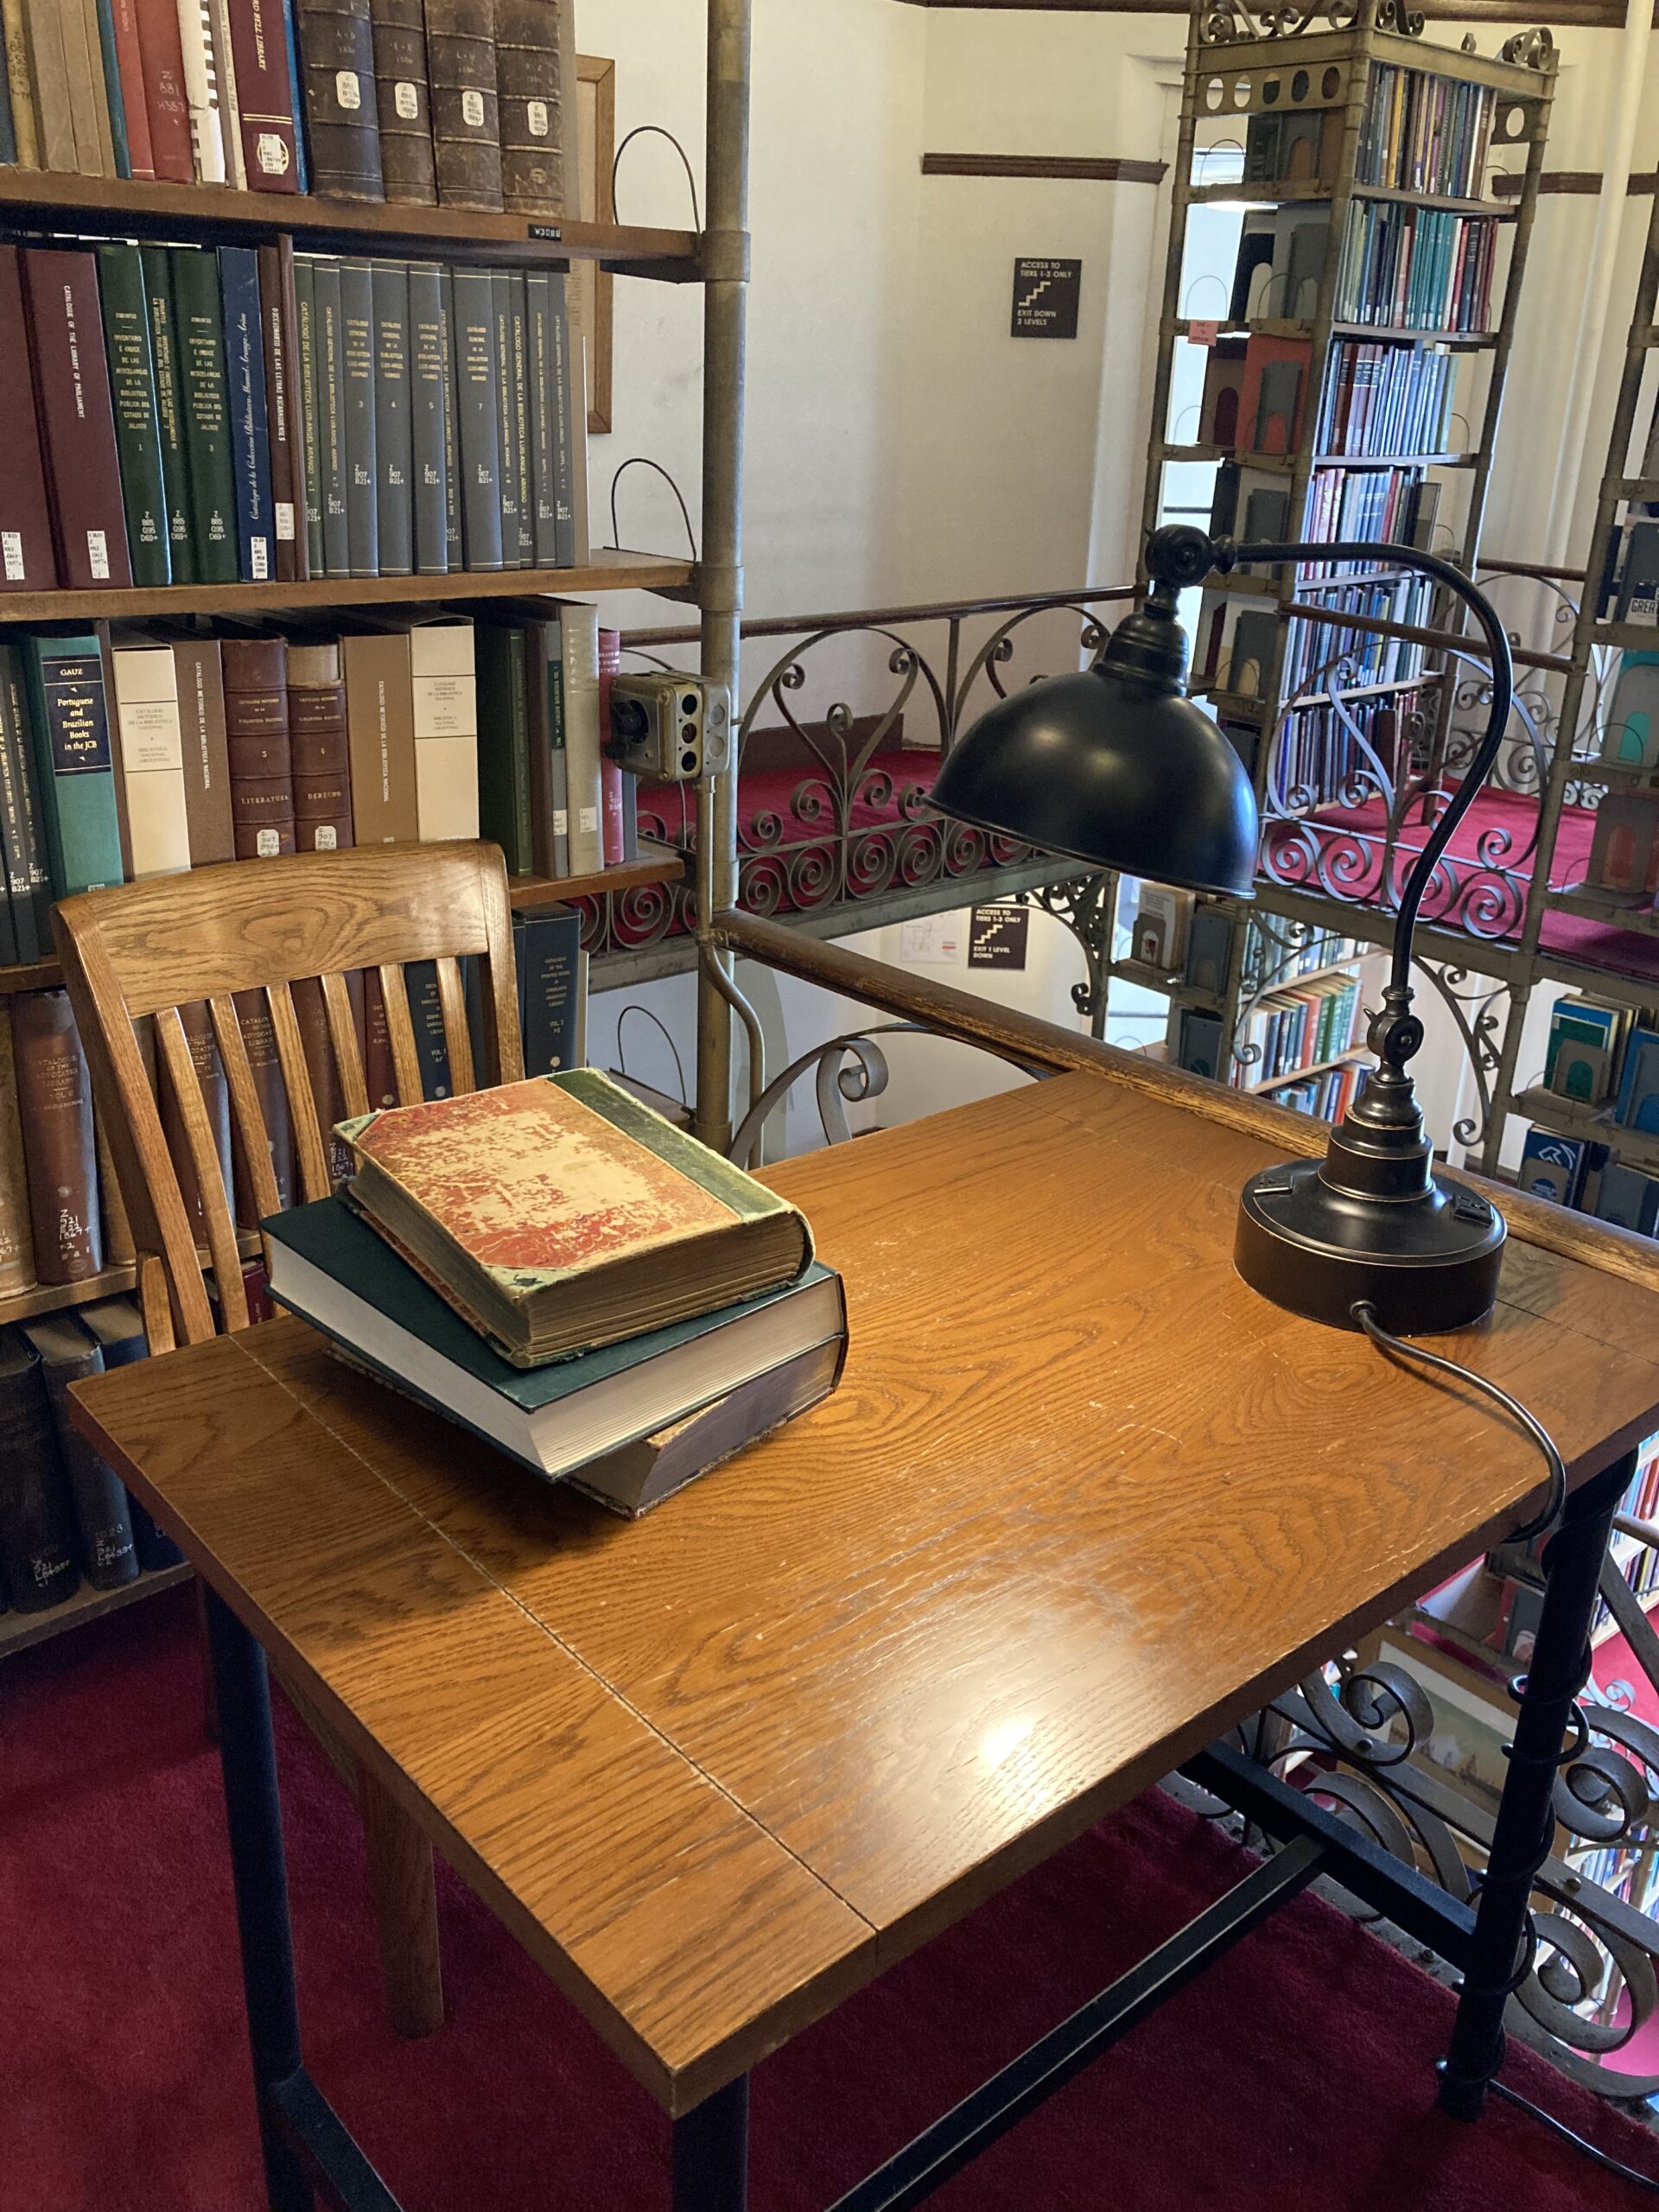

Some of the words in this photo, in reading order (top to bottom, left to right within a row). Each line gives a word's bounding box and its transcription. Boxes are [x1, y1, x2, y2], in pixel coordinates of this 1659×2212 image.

[255, 35, 266, 71] LIBRARY
[162, 71, 172, 79] Z
[63, 285, 73, 318] CATALOGUE
[272, 308, 281, 347] DICCIONARIO
[302, 341, 309, 351] DE
[70, 346, 79, 370] LIBRARY
[302, 353, 310, 362] LA
[515, 352, 524, 381] GENERAL
[303, 364, 312, 404] BIBLIOTECA
[517, 382, 524, 391] DE
[74, 383, 85, 418] PARLIAMENT
[517, 392, 524, 402] LA
[276, 396, 286, 442] NICARAGUENSES
[518, 403, 526, 439] BIBLIOTECA
[57, 698, 93, 707] Portuguese
[70, 708, 84, 716] and
[62, 720, 94, 728] Brazilian
[69, 730, 90, 739] Books
[85, 741, 98, 750] JCB
[200, 734, 208, 763] BIBLIOTECA
[202, 765, 211, 790] NACIONAL
[241, 794, 289, 804] LITERATURA
[308, 791, 341, 800] DERECHO
[60, 1209, 68, 1217] Z
